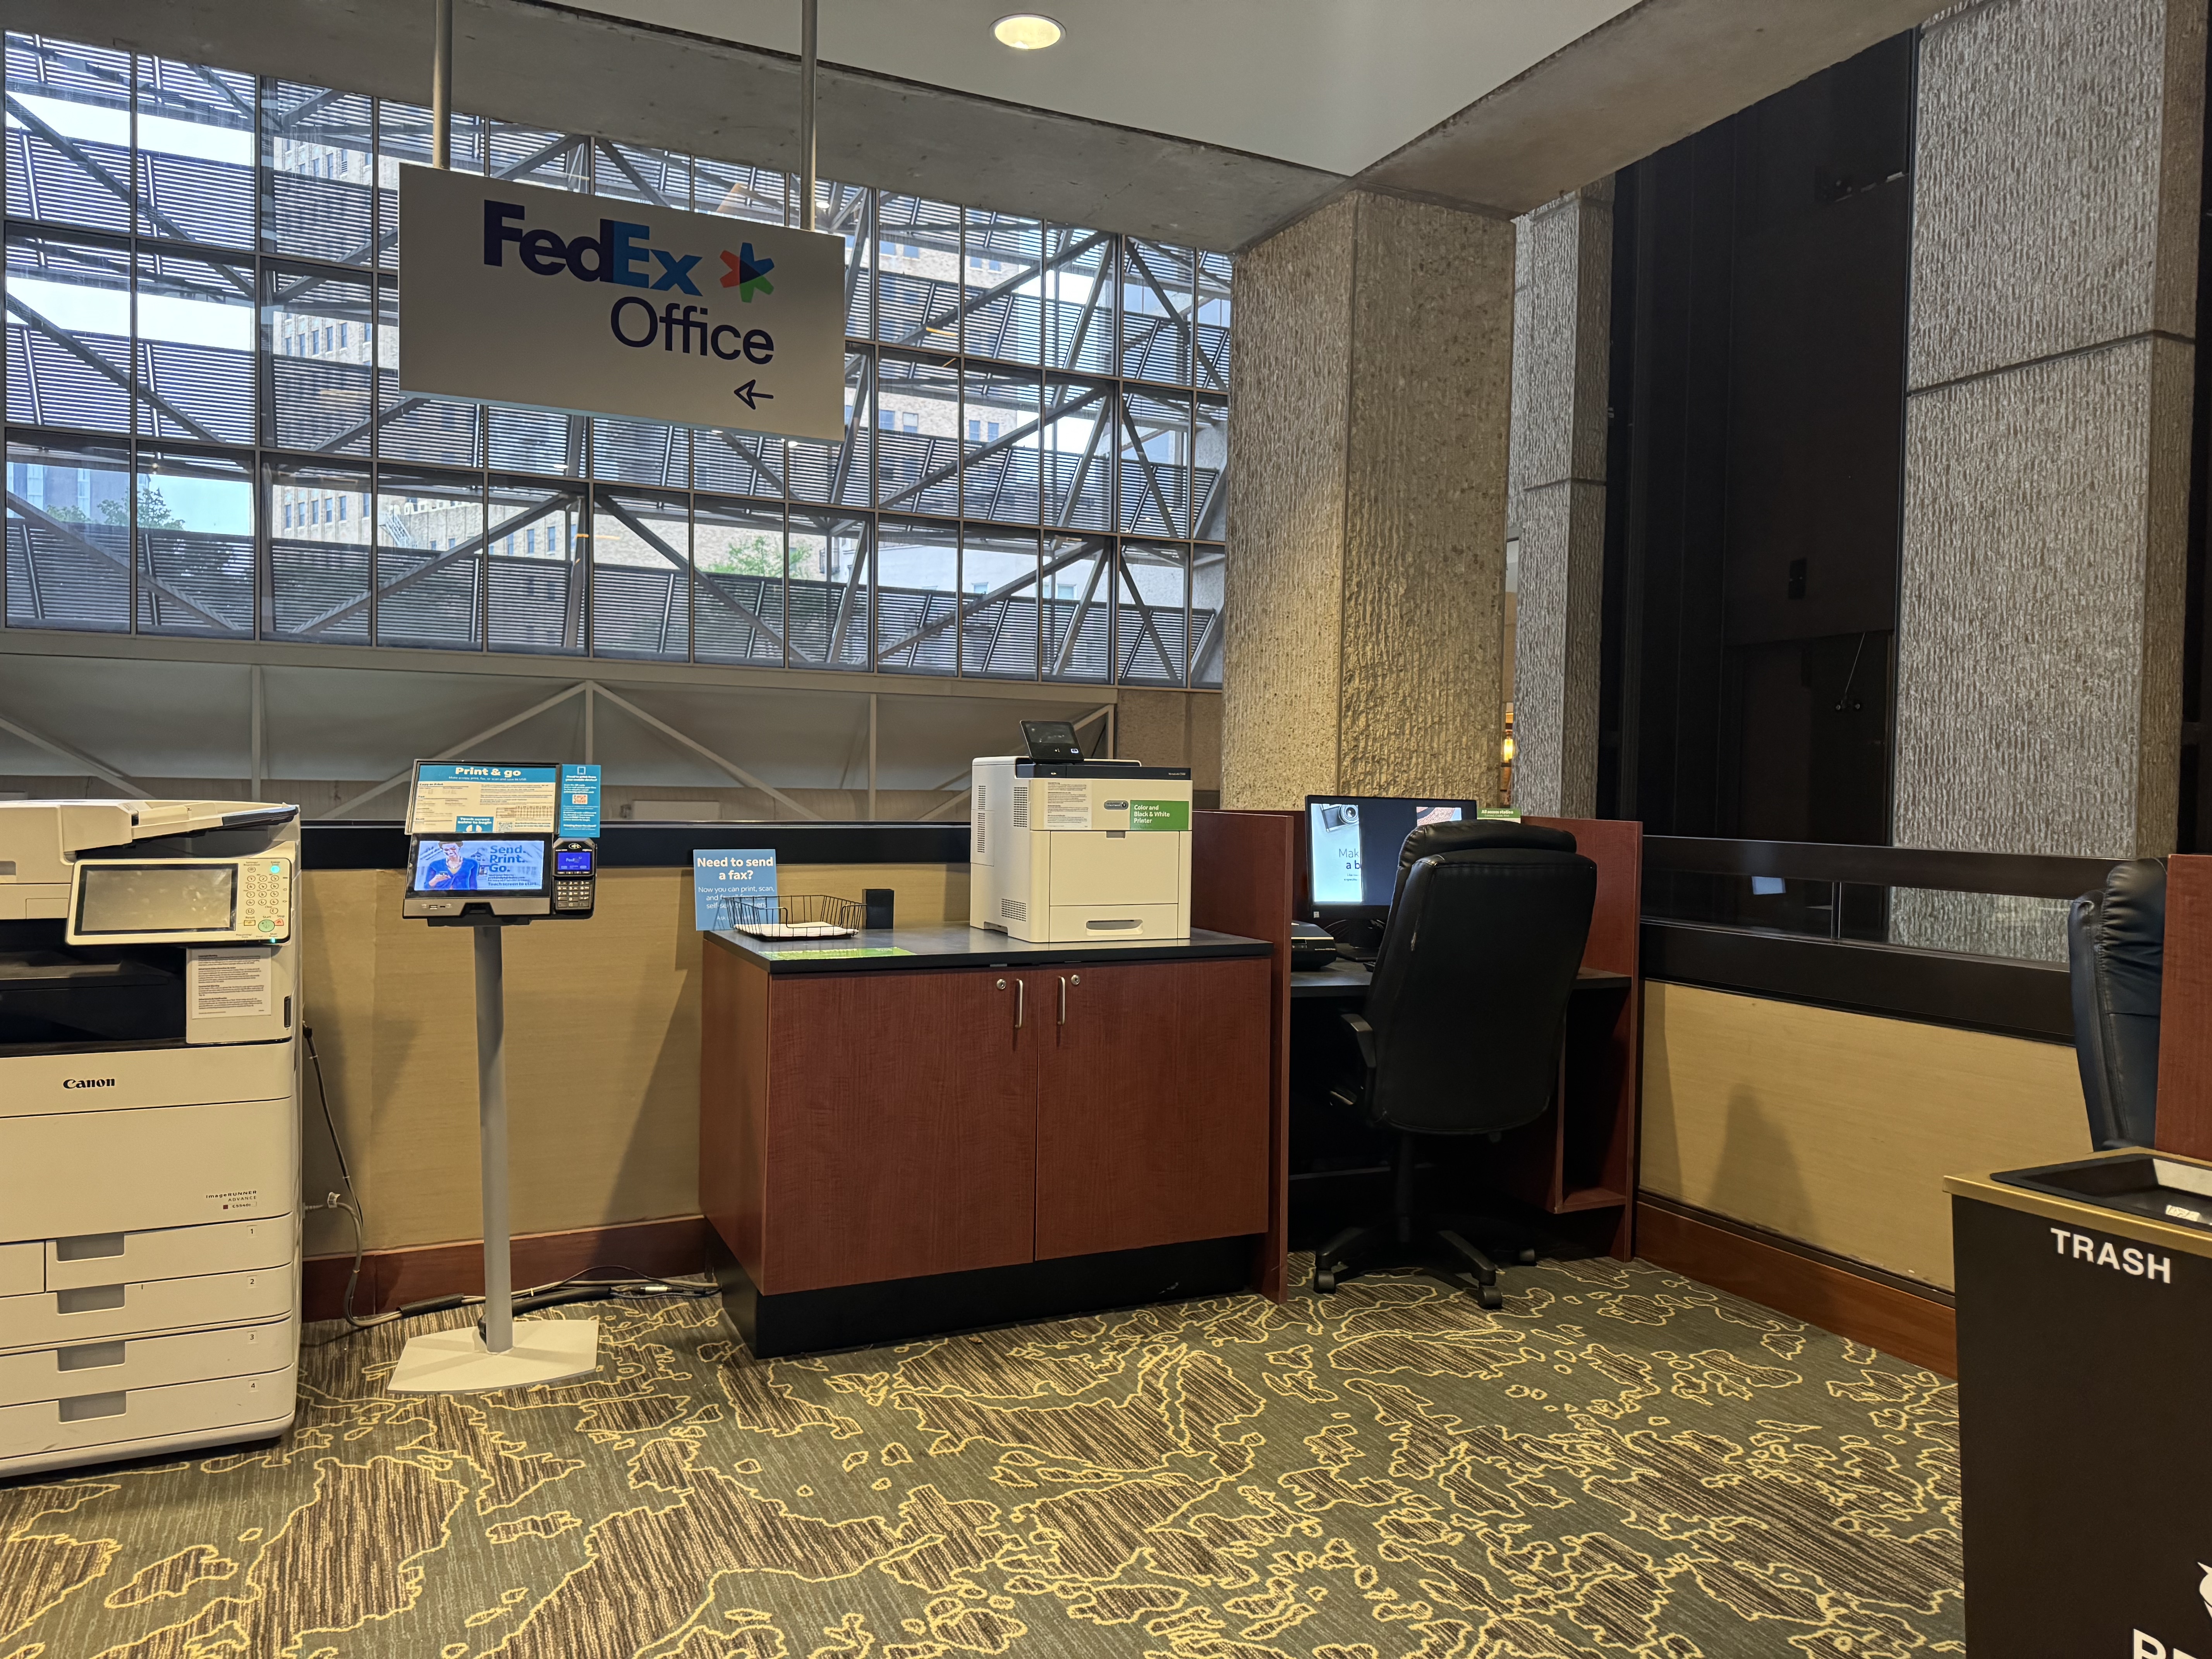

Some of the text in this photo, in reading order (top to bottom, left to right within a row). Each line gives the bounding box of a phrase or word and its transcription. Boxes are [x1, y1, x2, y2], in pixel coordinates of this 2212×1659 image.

[484, 199, 703, 297] FedEx
[611, 297, 774, 365] Office
[455, 767, 488, 775] Print
[490, 845, 526, 854] Send.
[697, 857, 773, 867] Need to send
[489, 863, 510, 872] Go.
[728, 870, 753, 880] fax?
[63, 1079, 115, 1089] Canon
[2051, 1227, 2171, 1284] TRASH
